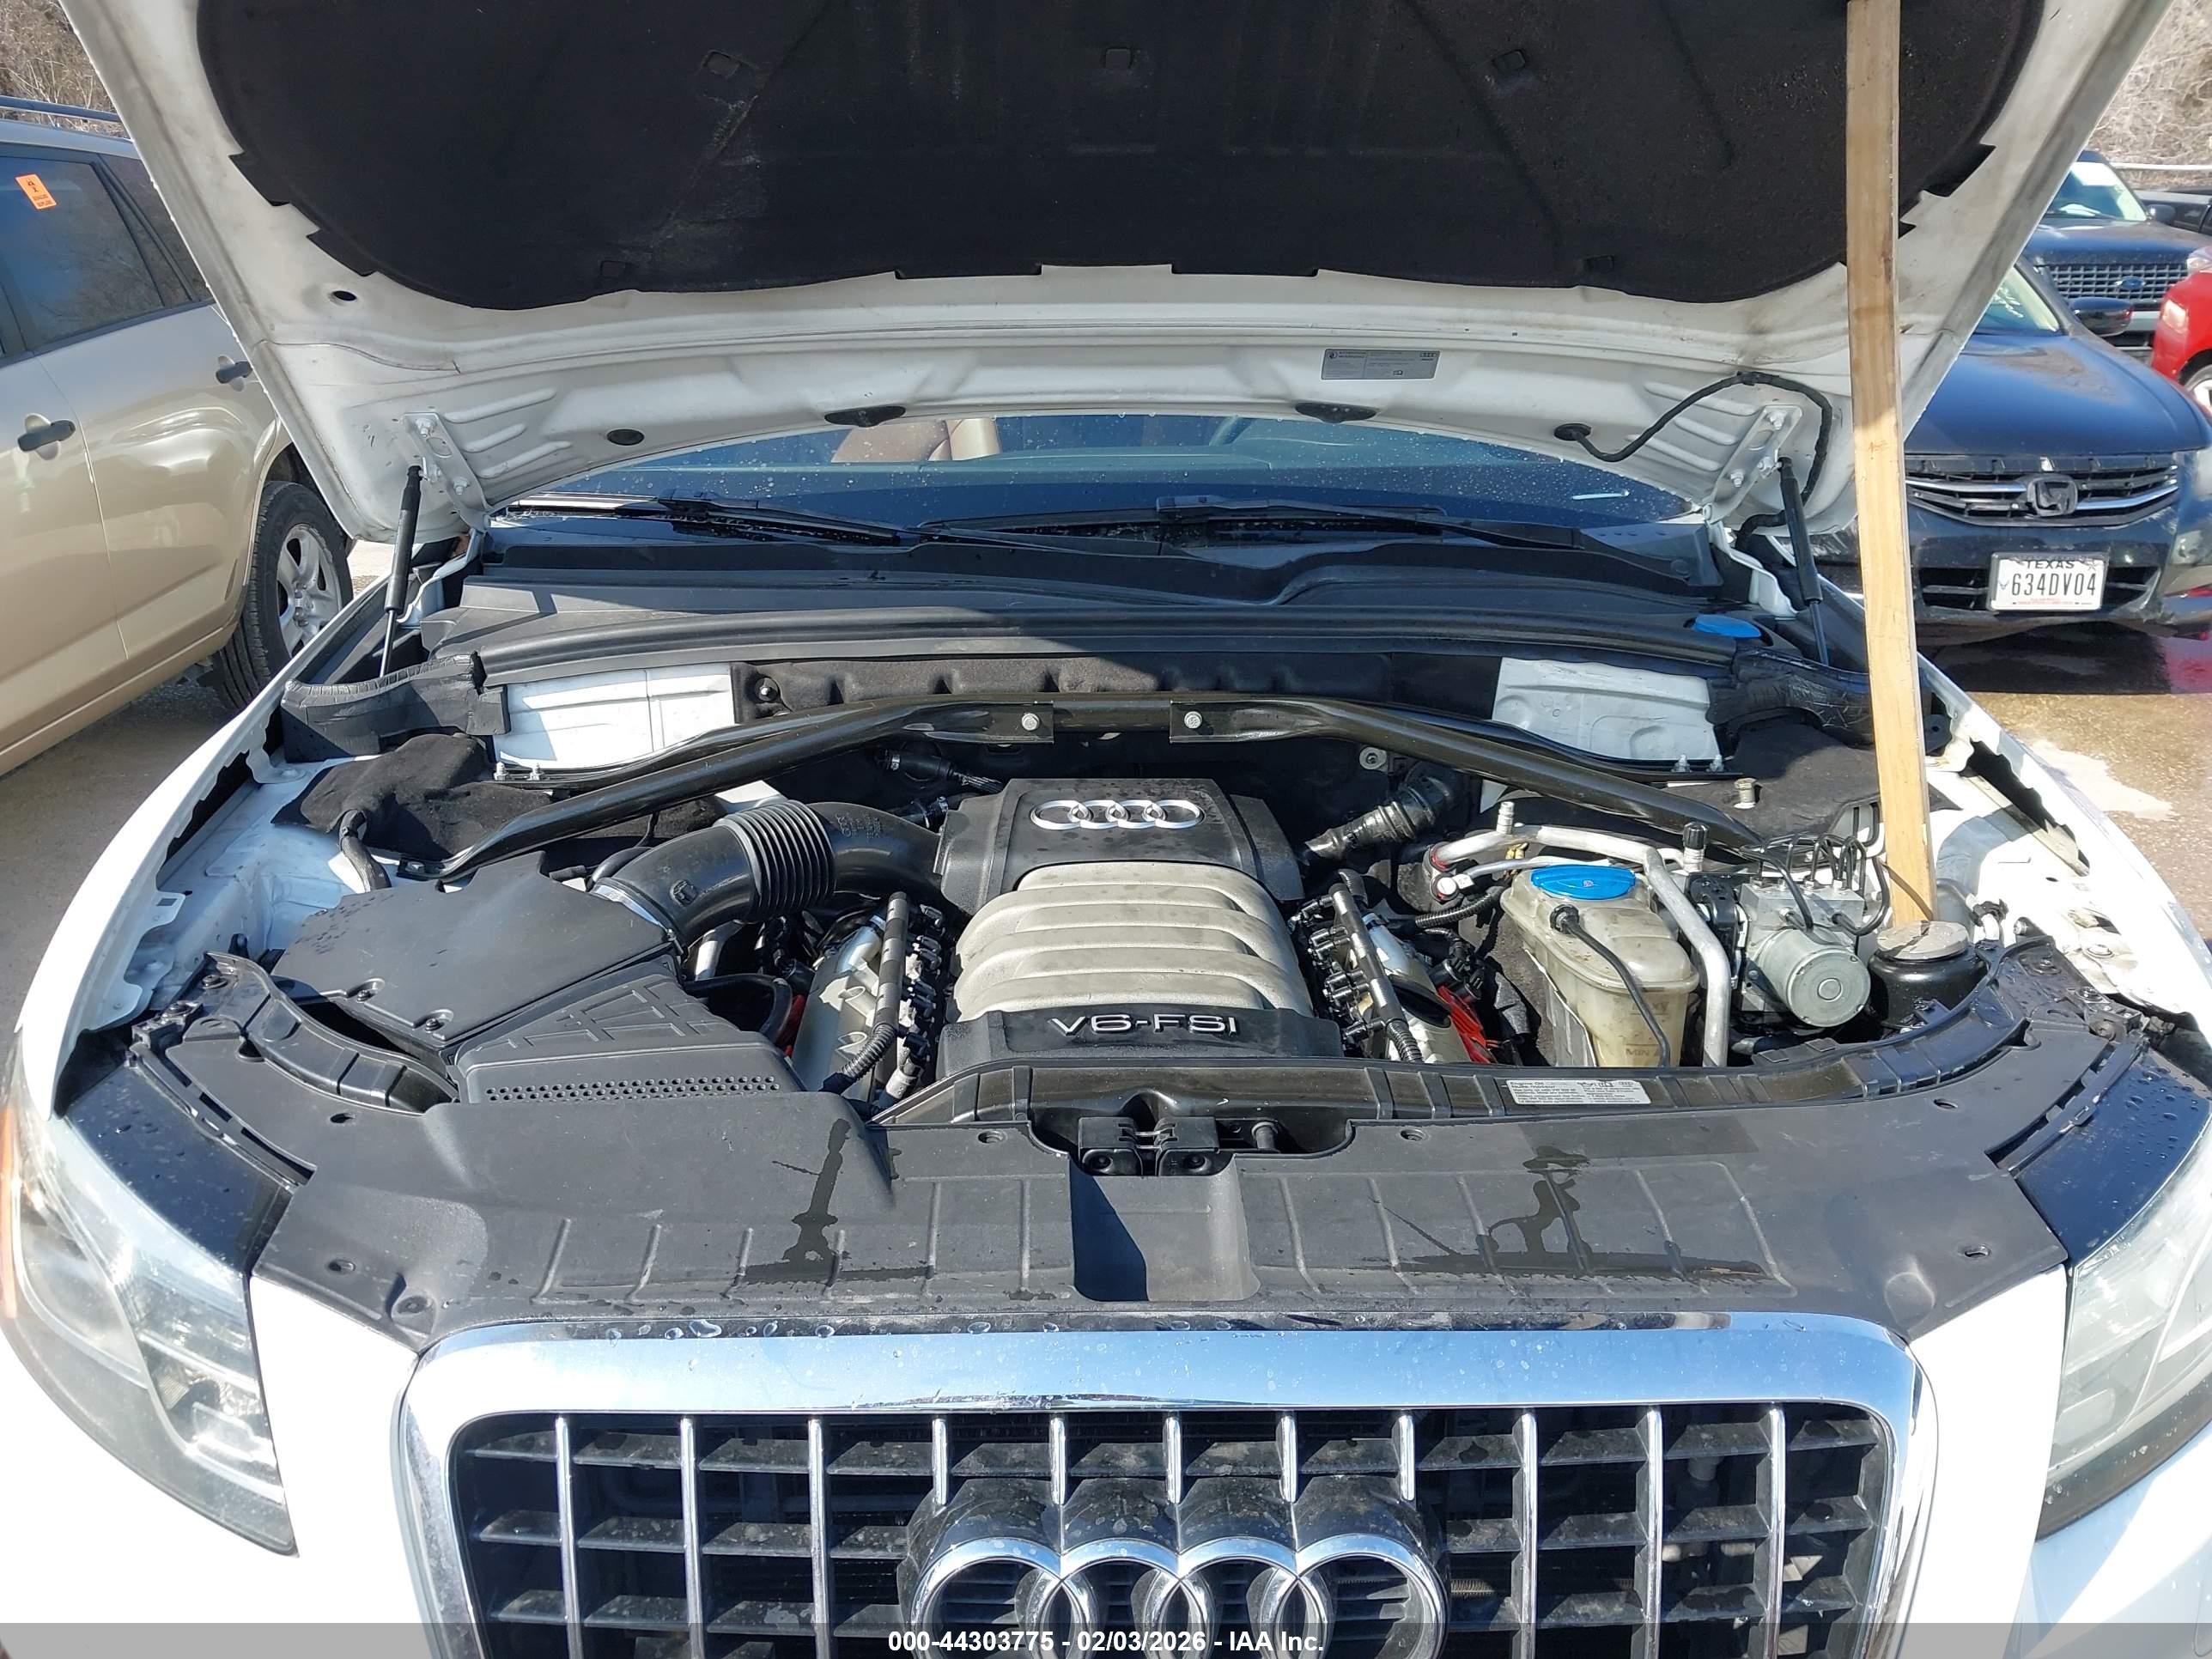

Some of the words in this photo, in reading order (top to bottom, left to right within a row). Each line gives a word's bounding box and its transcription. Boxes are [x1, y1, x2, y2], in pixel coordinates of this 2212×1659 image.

[2026, 560, 2075, 569] TEXAS
[2011, 573, 2096, 596] 634DV04
[1049, 1012, 1238, 1036] V6-FSI
[1626, 1048, 1650, 1056] MIN
